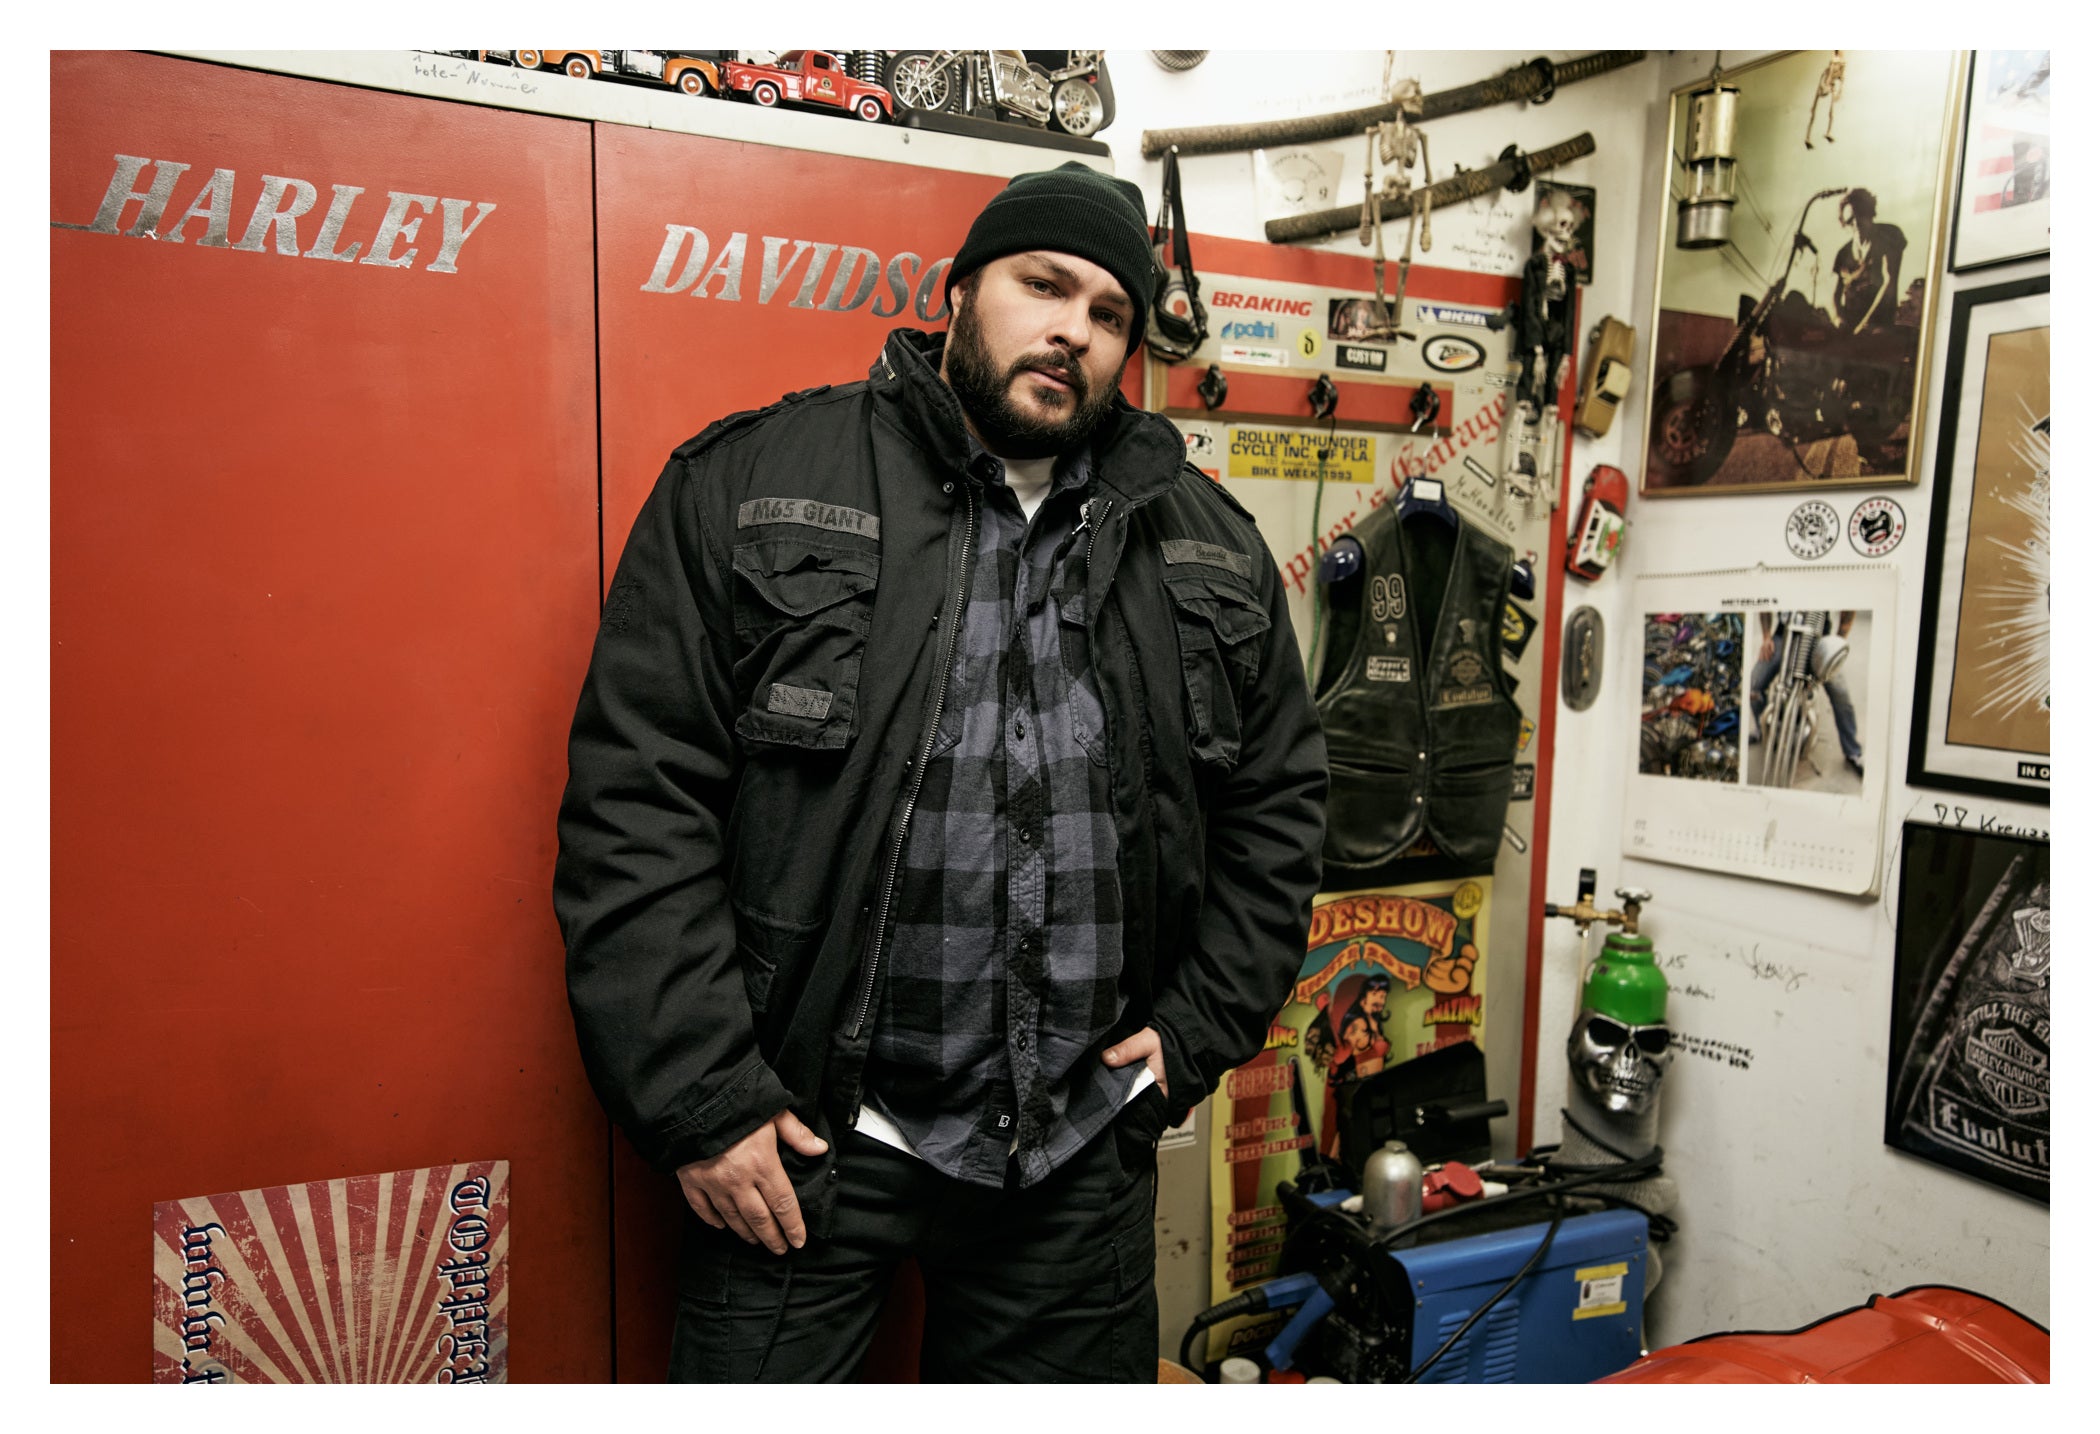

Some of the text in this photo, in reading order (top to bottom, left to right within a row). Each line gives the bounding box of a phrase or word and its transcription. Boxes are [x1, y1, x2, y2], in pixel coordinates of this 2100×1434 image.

[90, 154, 953, 322] HARLEY DAVIDSO
[1211, 291, 1313, 317] BRAKING
[1231, 443, 1278, 457] CYCLE
[1300, 434, 1369, 449] THUNDER
[1252, 466, 1279, 477] BIKE
[1284, 467, 1319, 479] WEEK
[752, 500, 867, 530] M65 GIANT
[1371, 573, 1407, 622] 99
[2021, 764, 2036, 778] IN
[1308, 898, 1455, 950] DESHOW
[1424, 994, 1483, 1028] AMAZING
[2002, 1002, 2031, 1028] THE
[1264, 1025, 1298, 1050] LING
[1227, 1063, 1295, 1100] CHOPPERS
[1939, 1100, 2050, 1167] Evolut
[180, 1222, 227, 1384] www.t
